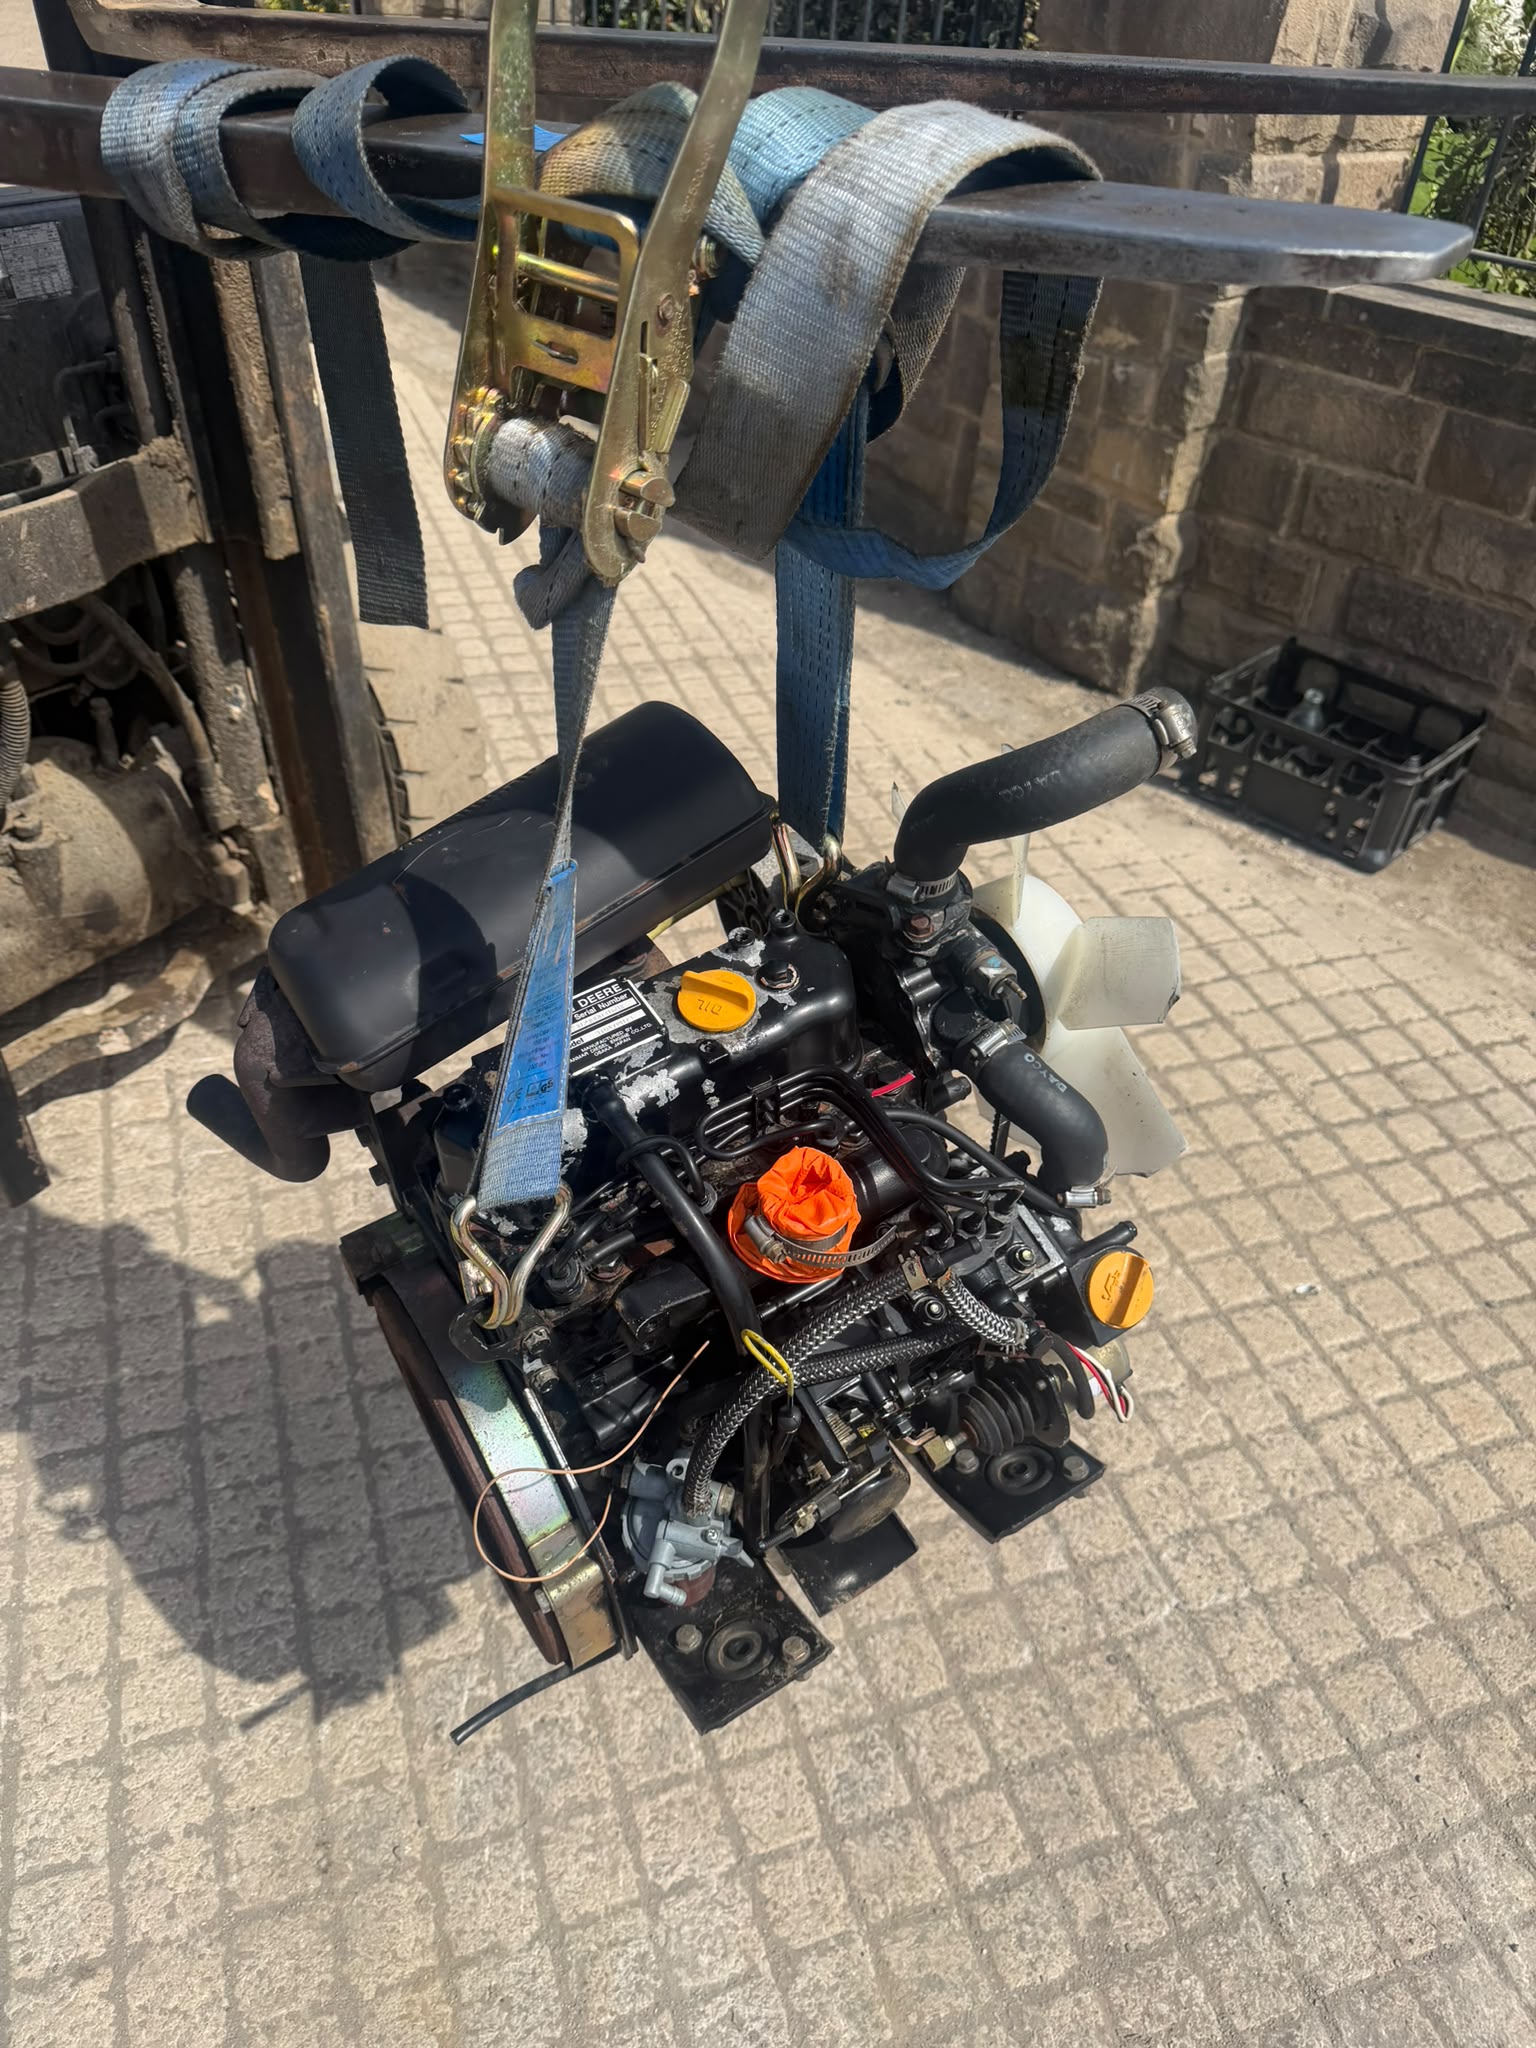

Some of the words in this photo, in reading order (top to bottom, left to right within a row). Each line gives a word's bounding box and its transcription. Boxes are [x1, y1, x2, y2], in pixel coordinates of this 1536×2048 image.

[574, 1006, 597, 1020] Serial
[597, 994, 628, 1010] Number
[577, 984, 622, 1007] DEERE
[569, 1050, 589, 1063] ANMAR
[590, 1042, 609, 1054] DIESEL
[609, 1033, 630, 1045] ENGINE
[570, 1037, 584, 1047] del
[580, 1030, 624, 1052] MANUFACTURED
[594, 1046, 613, 1057] OSAKA
[614, 1036, 631, 1048] JAPAN
[1024, 1052, 1068, 1093] DAYCO
